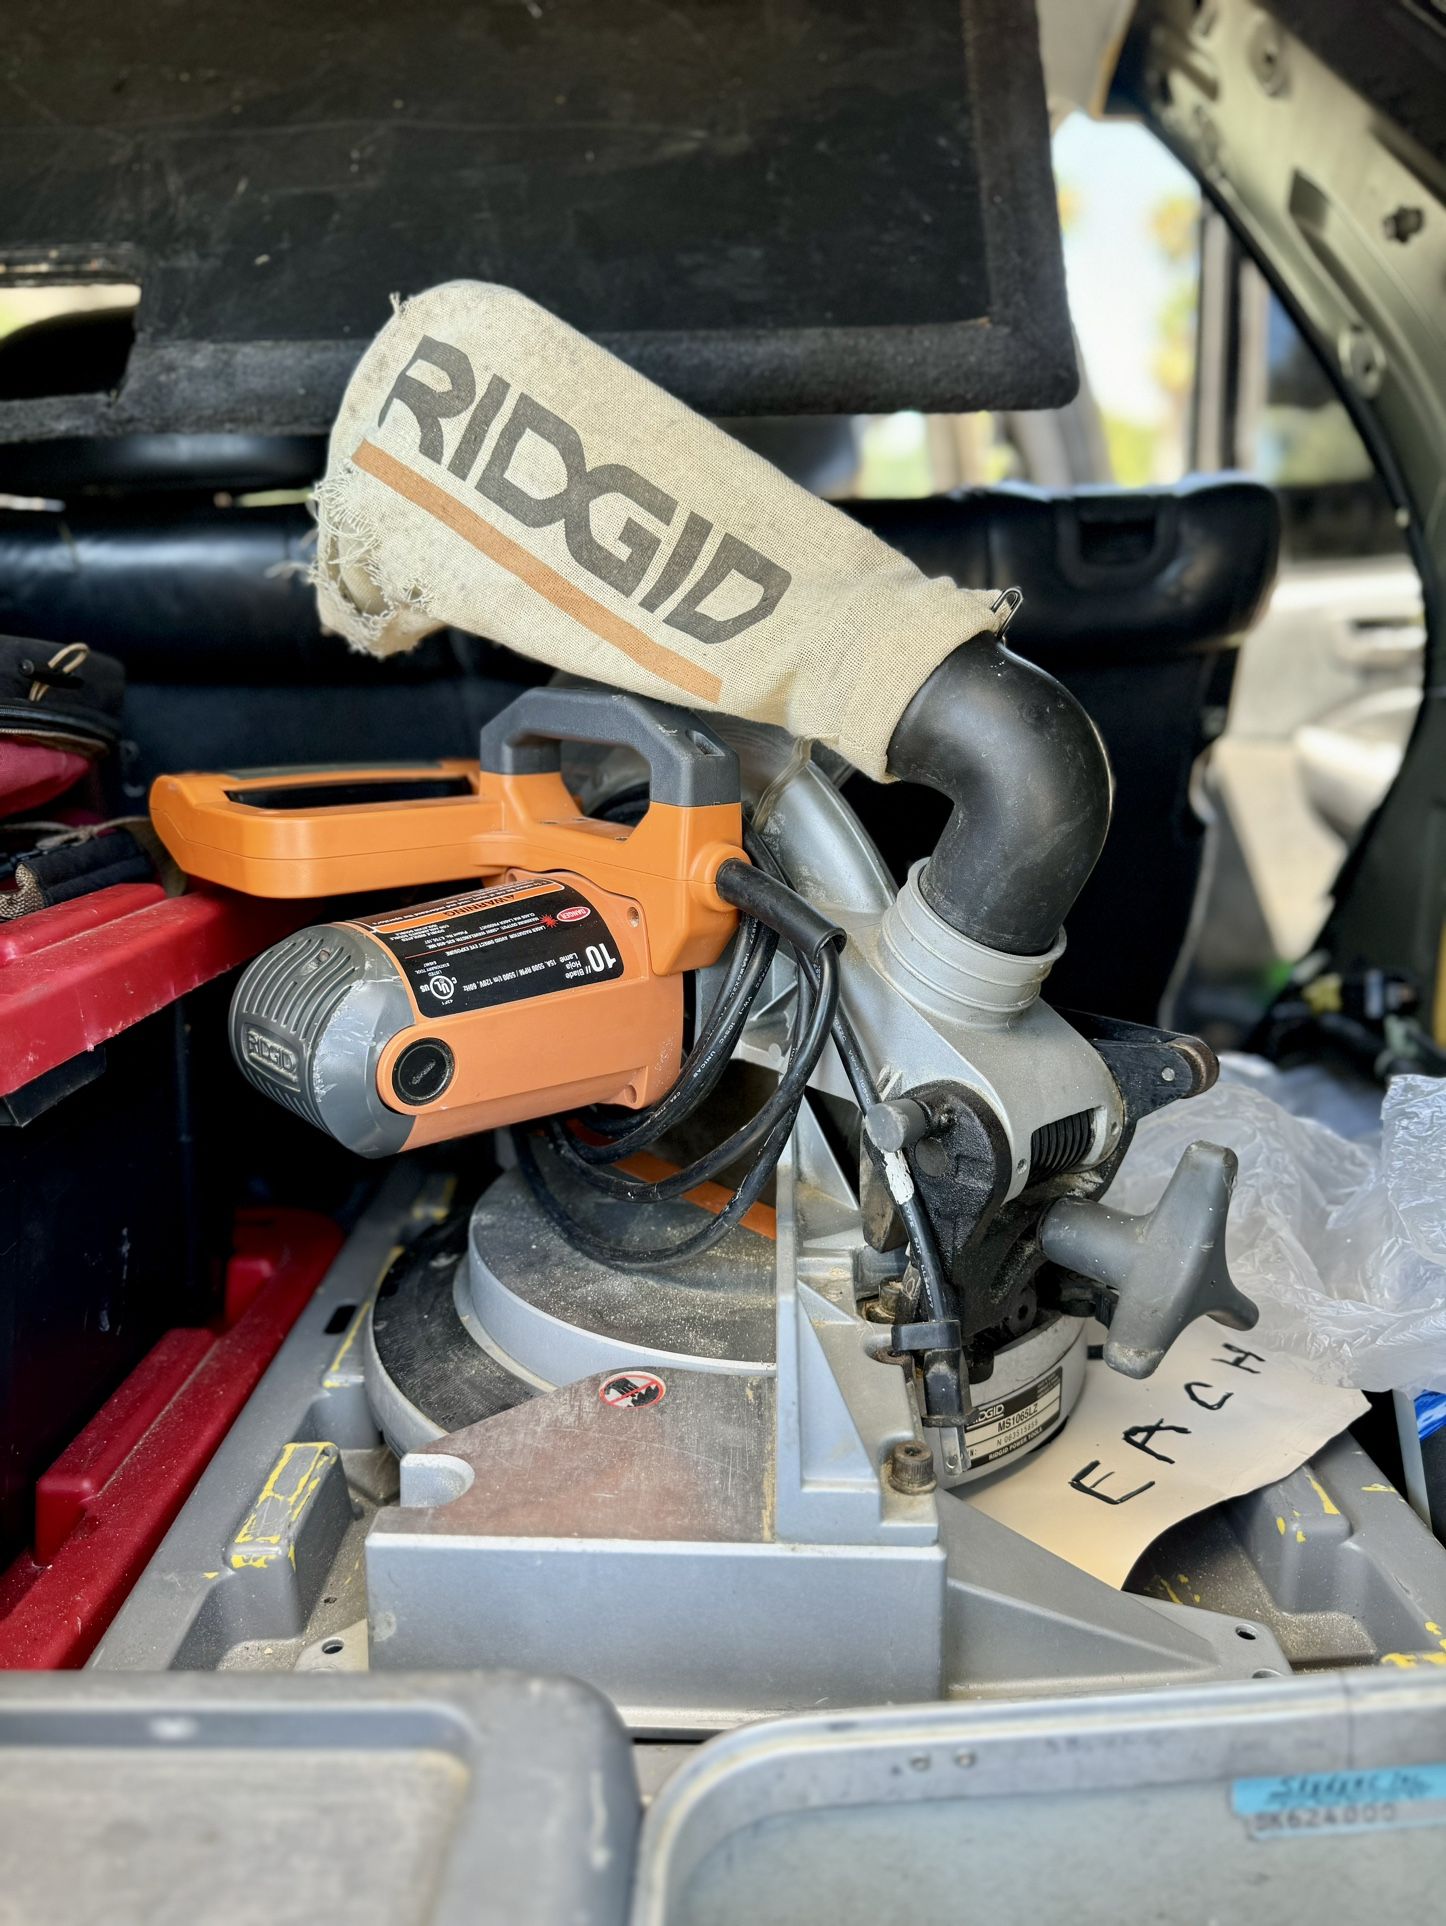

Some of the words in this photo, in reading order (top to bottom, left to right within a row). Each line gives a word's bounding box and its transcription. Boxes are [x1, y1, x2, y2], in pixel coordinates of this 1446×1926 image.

[378, 335, 792, 644] RIDGID
[443, 896, 508, 916] WARNING
[560, 908, 586, 919] DANGER
[445, 947, 469, 956] EXPOSURE
[559, 953, 578, 963] Lame
[565, 960, 581, 969] Hoja
[502, 972, 516, 980] 5500
[519, 967, 532, 975] RPM
[565, 968, 584, 979] Blade
[420, 984, 430, 992] US
[463, 983, 477, 991] 60Hz
[247, 1029, 297, 1076] RIDGID
[973, 1403, 1005, 1424] DGID
[997, 1403, 1038, 1432] MS1065LZ
[1068, 1343, 1266, 1505] EACH
[988, 1447, 1009, 1460] RIDGID
[1010, 1438, 1027, 1451] POWER
